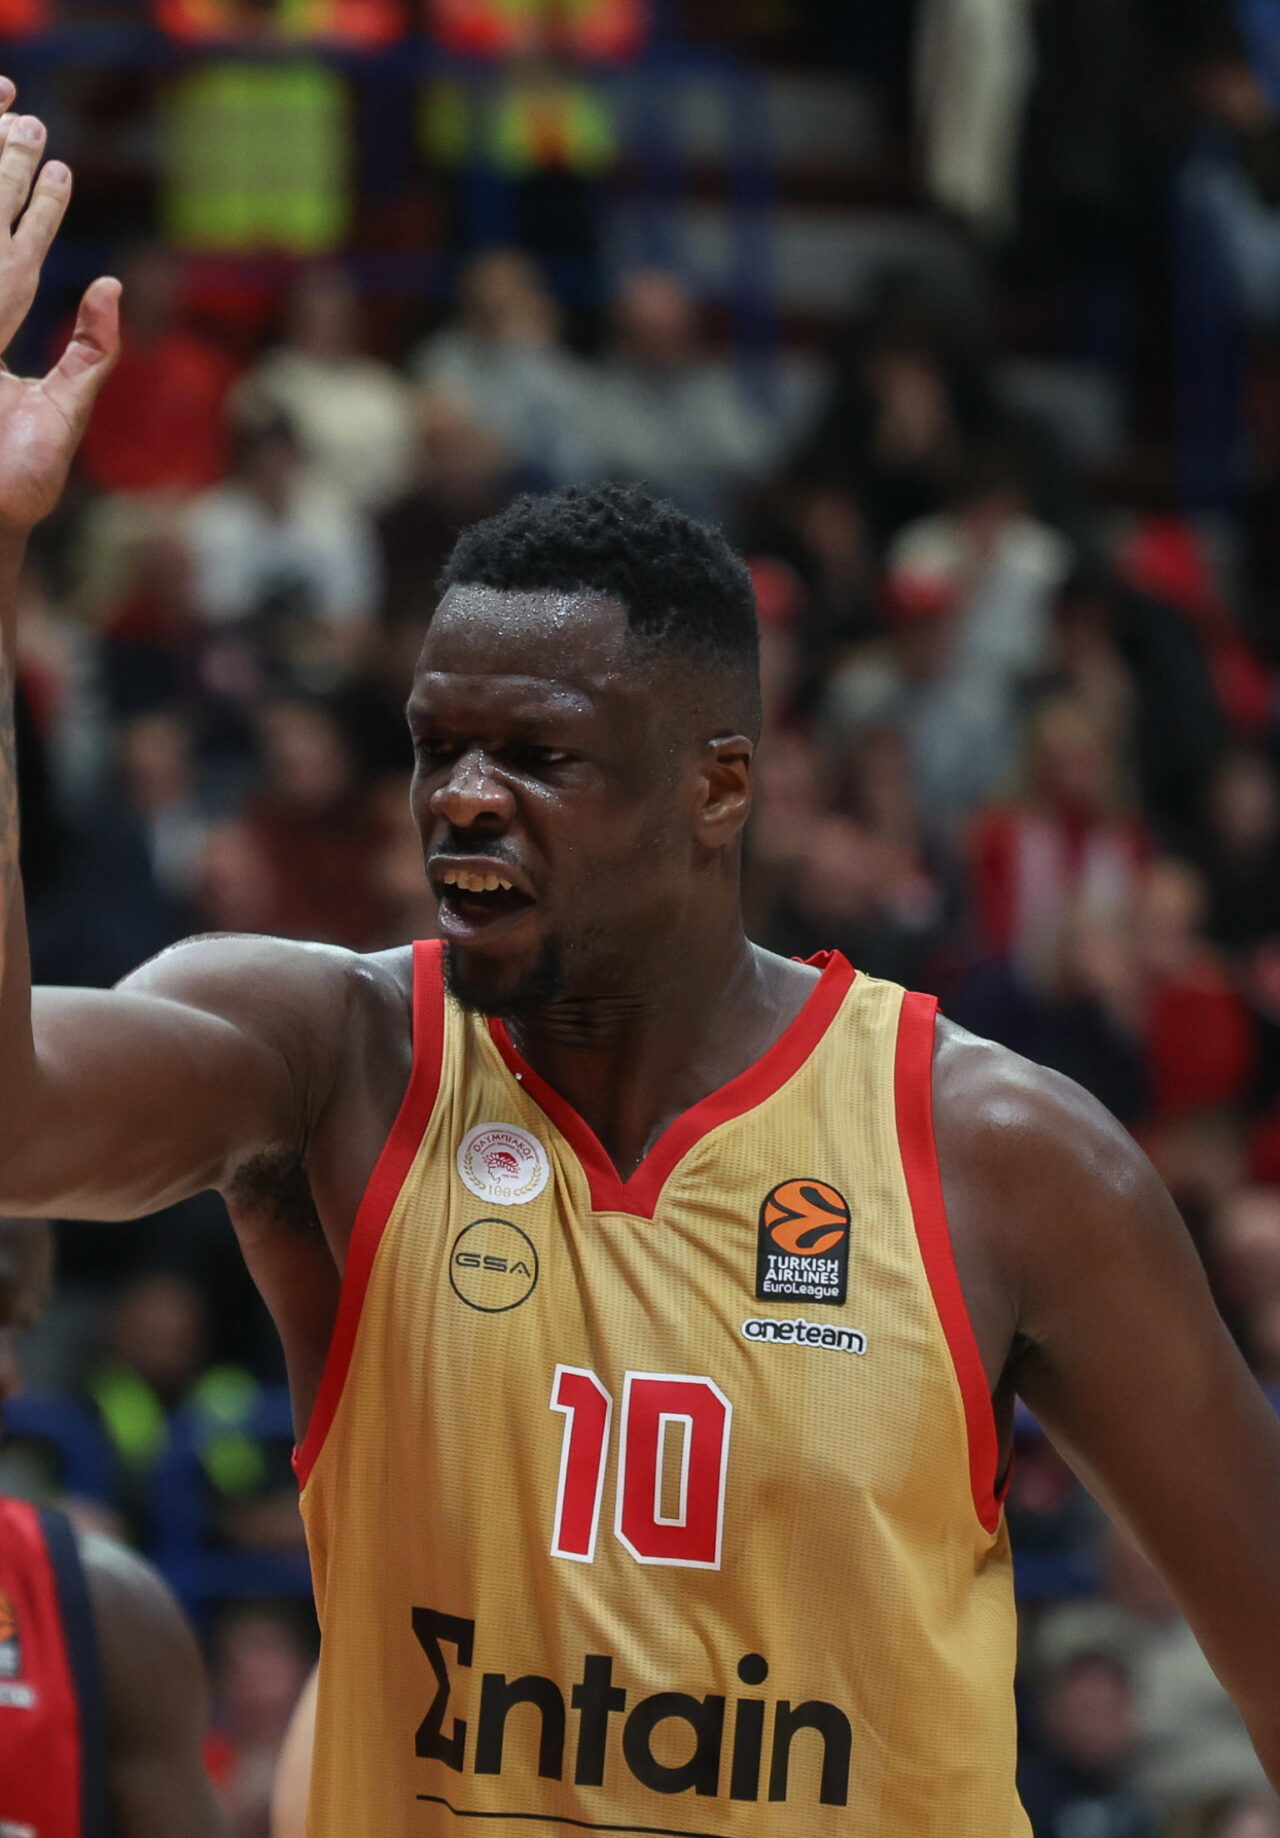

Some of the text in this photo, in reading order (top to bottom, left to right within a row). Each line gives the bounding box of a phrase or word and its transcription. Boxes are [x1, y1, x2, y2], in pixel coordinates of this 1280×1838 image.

[455, 1252, 532, 1278] GSA
[767, 1255, 839, 1273] TURKISH
[764, 1268, 839, 1285] AIRLINES
[763, 1281, 840, 1299] EuroLeague
[744, 1320, 864, 1353] oneteam
[549, 1363, 734, 1571] 10
